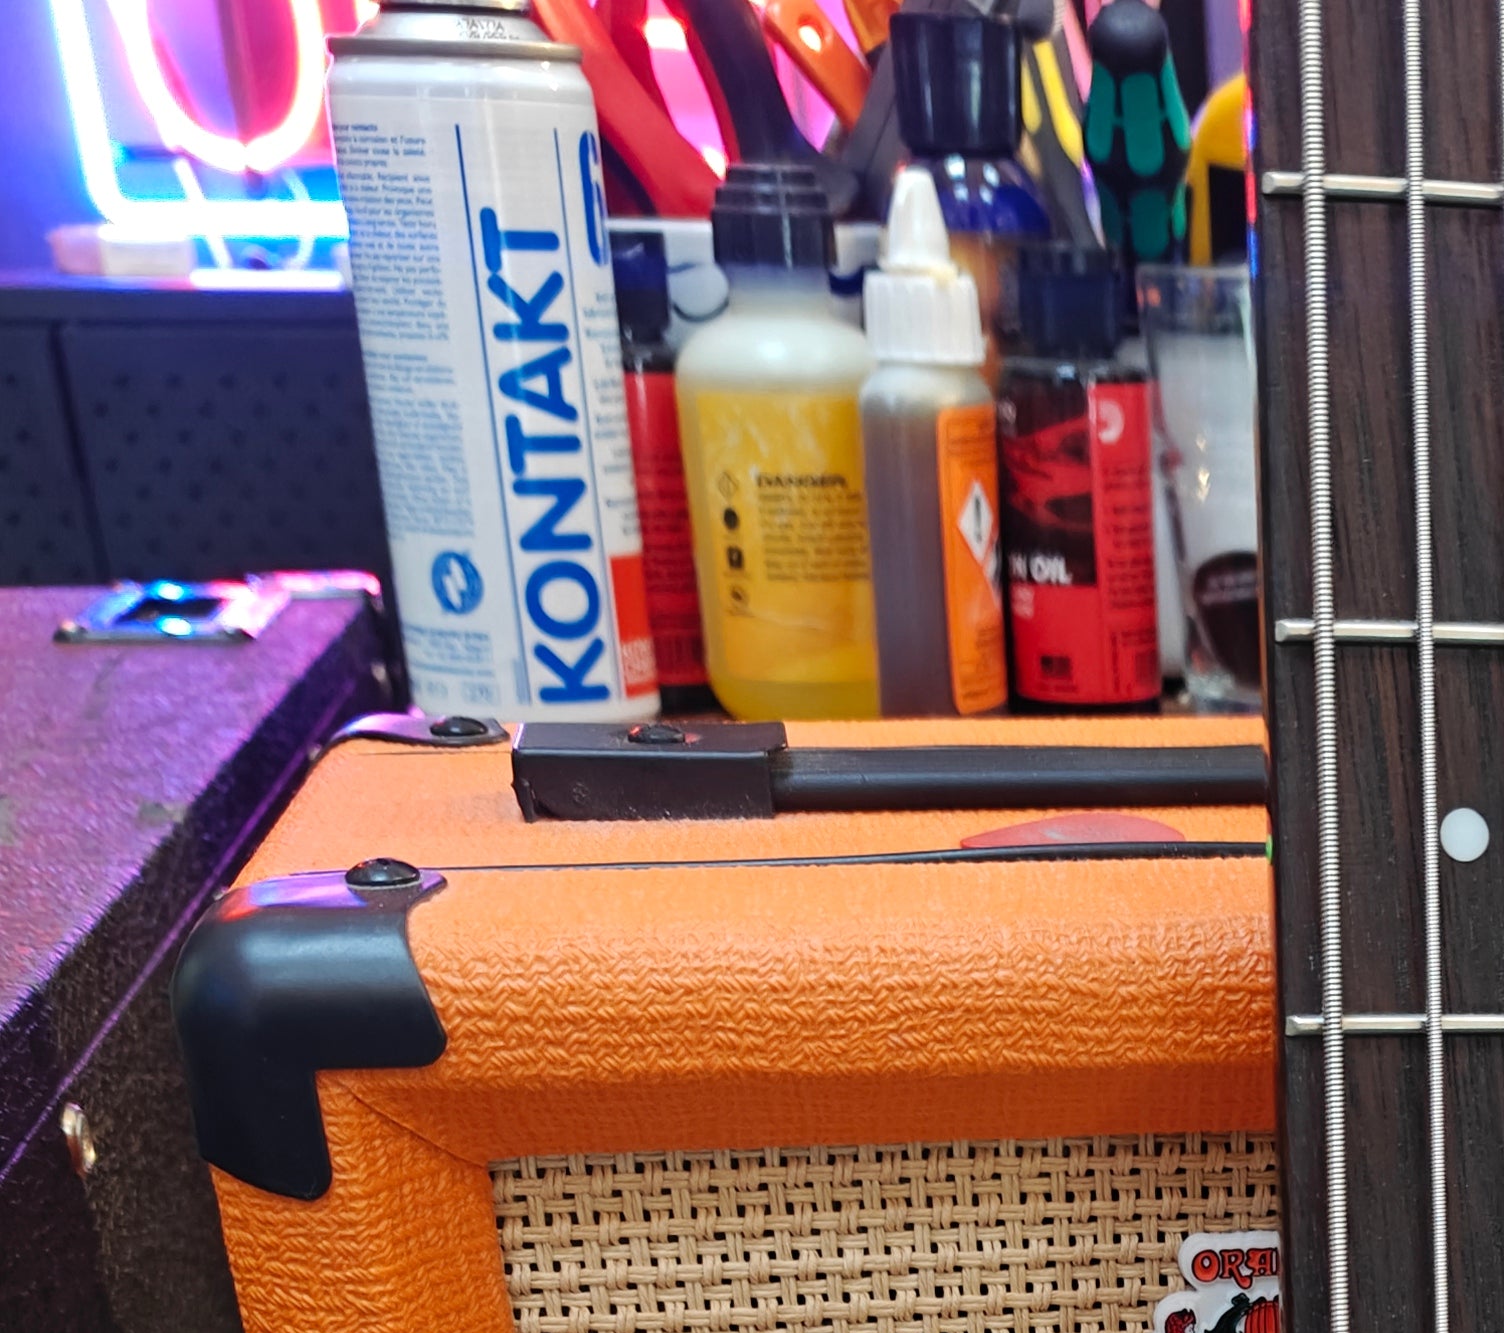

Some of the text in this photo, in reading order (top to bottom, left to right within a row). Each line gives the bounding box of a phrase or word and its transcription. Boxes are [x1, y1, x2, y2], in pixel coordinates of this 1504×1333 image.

[480, 206, 611, 705] KONTAKT
[1030, 553, 1073, 585] OIL
[1191, 1247, 1280, 1290] ORA
